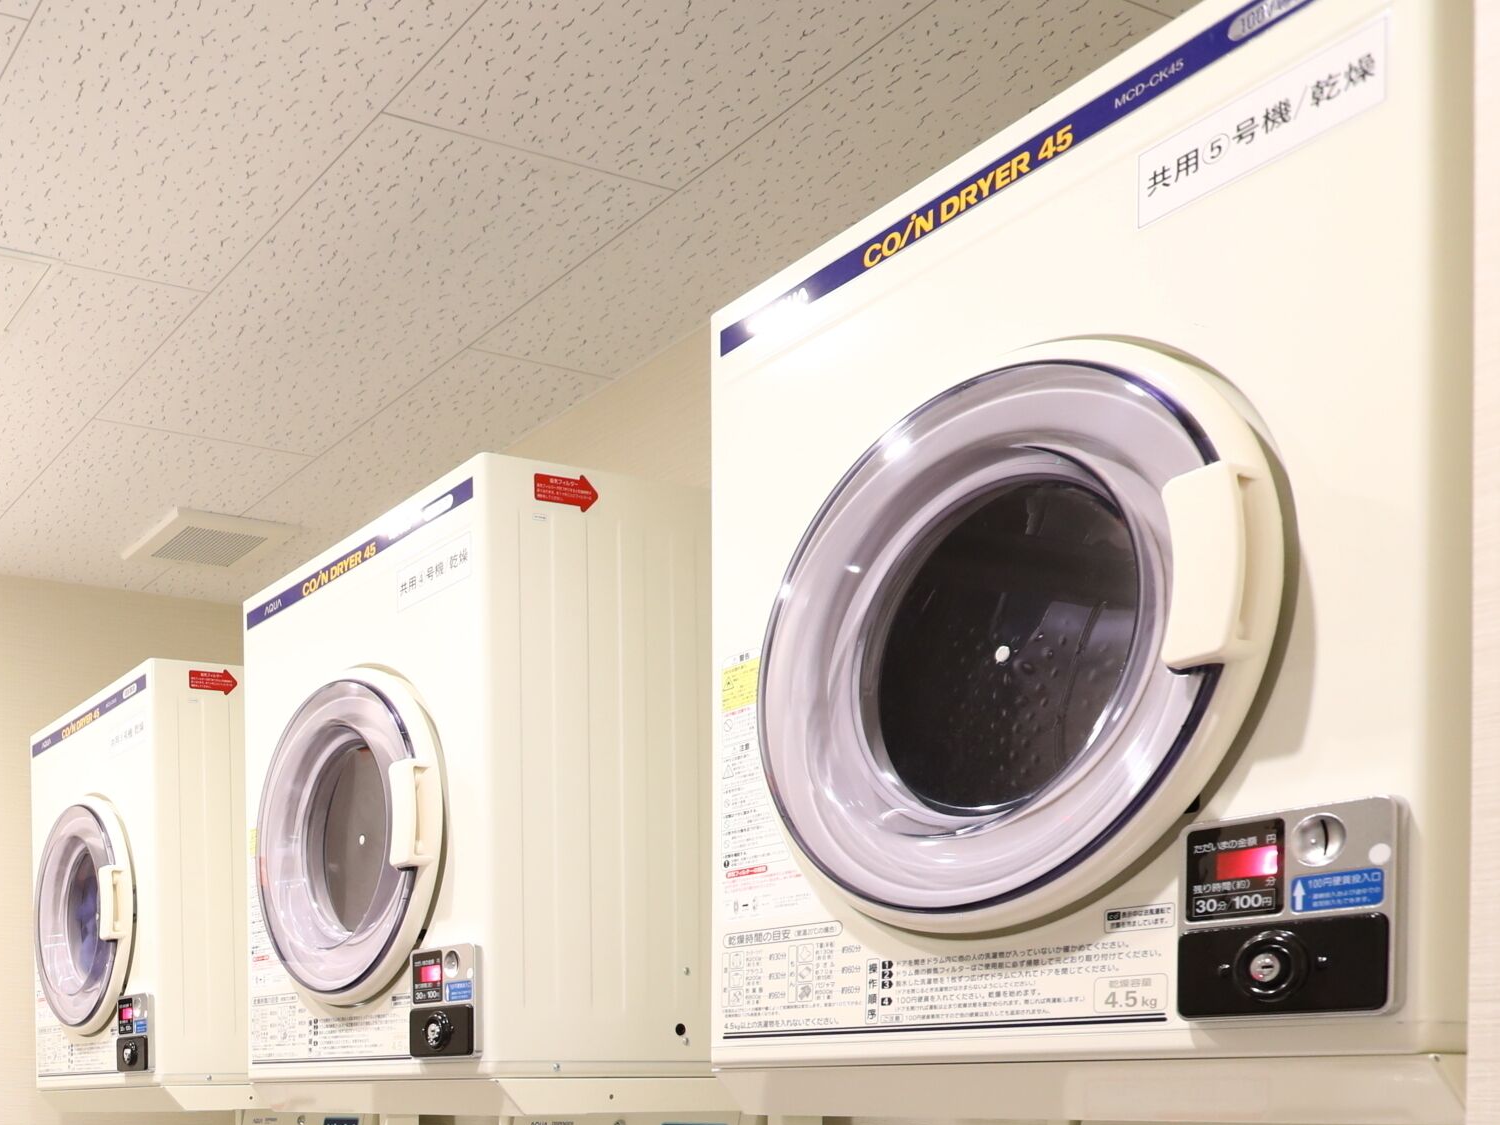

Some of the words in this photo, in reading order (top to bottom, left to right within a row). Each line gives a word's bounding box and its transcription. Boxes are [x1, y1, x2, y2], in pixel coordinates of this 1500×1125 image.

[1114, 58, 1184, 109] MCD-CK45
[940, 151, 1031, 224] DRYER
[1037, 124, 1074, 161] 45
[264, 598, 283, 616] AQUA
[330, 553, 362, 581] DRYER
[363, 541, 376, 559] 45
[1266, 833, 1277, 844] 円
[1265, 876, 1276, 887] 分
[1104, 990, 1138, 1009] 4.5
[1141, 995, 1158, 1009] kg
